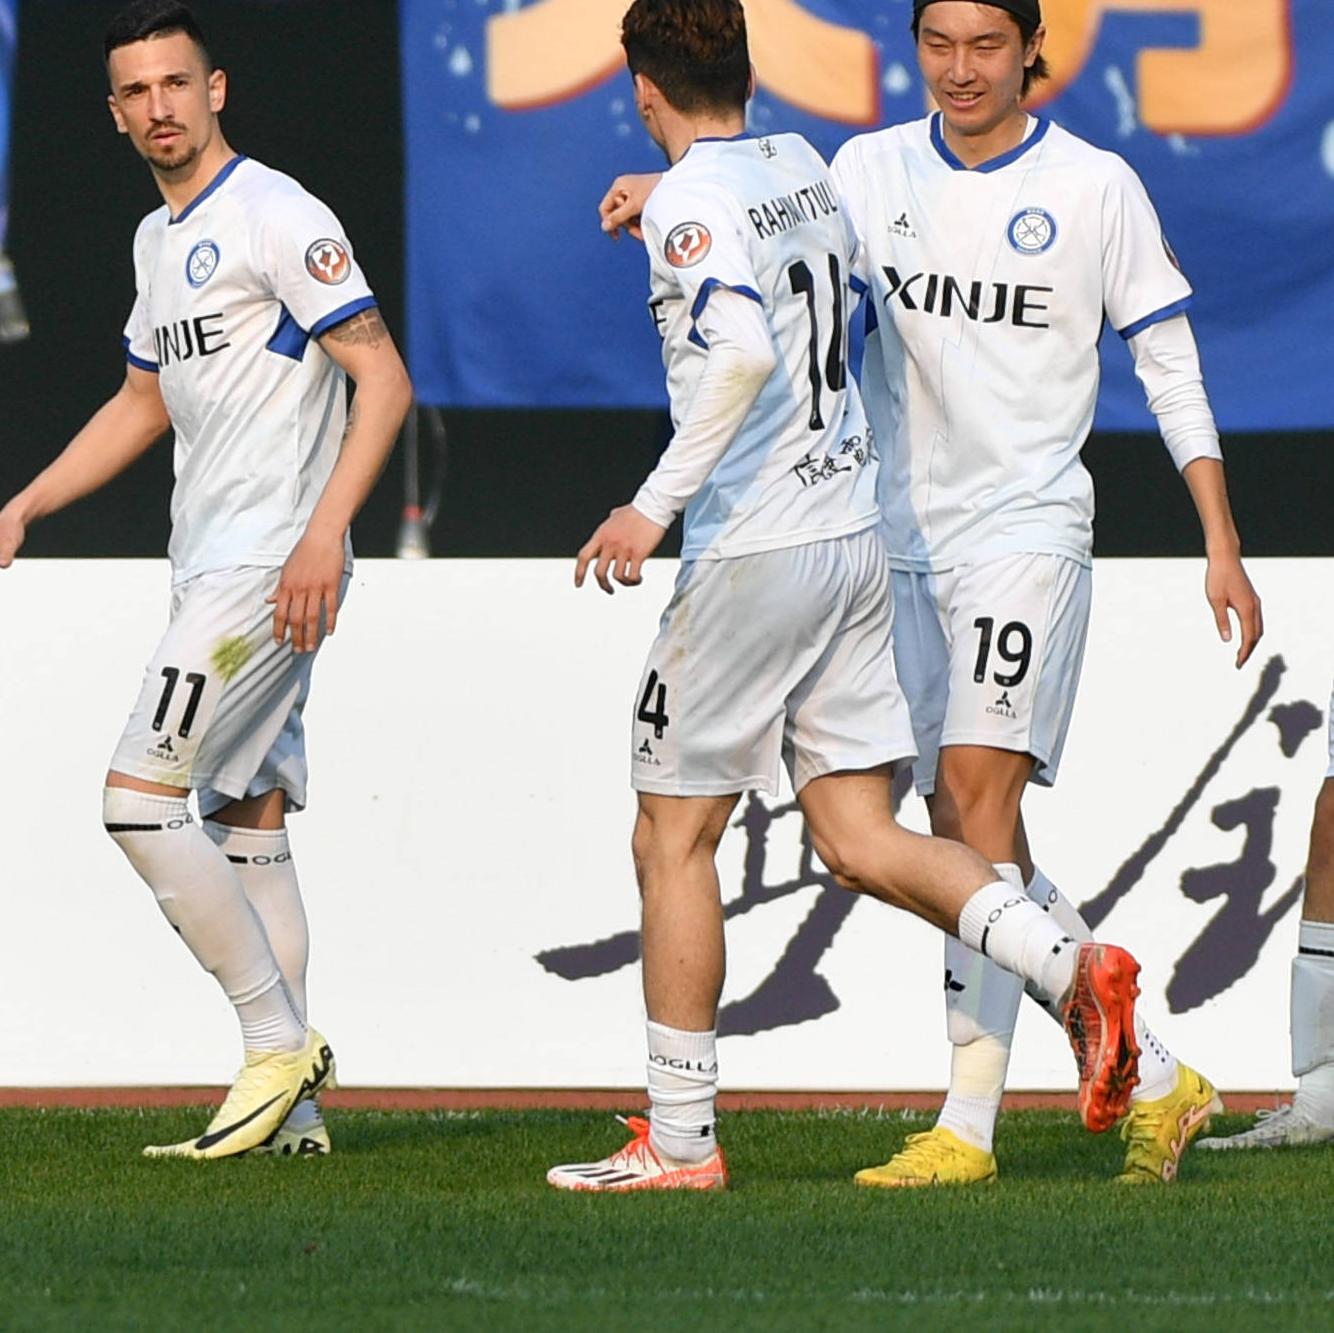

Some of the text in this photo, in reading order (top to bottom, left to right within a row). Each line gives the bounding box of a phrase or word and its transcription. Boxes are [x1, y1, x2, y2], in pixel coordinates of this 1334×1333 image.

[881, 265, 1053, 329] XINJE
[152, 312, 231, 368] INJE
[973, 616, 1032, 688] 19
[151, 666, 207, 739] 11
[146, 747, 180, 764] OGLLA
